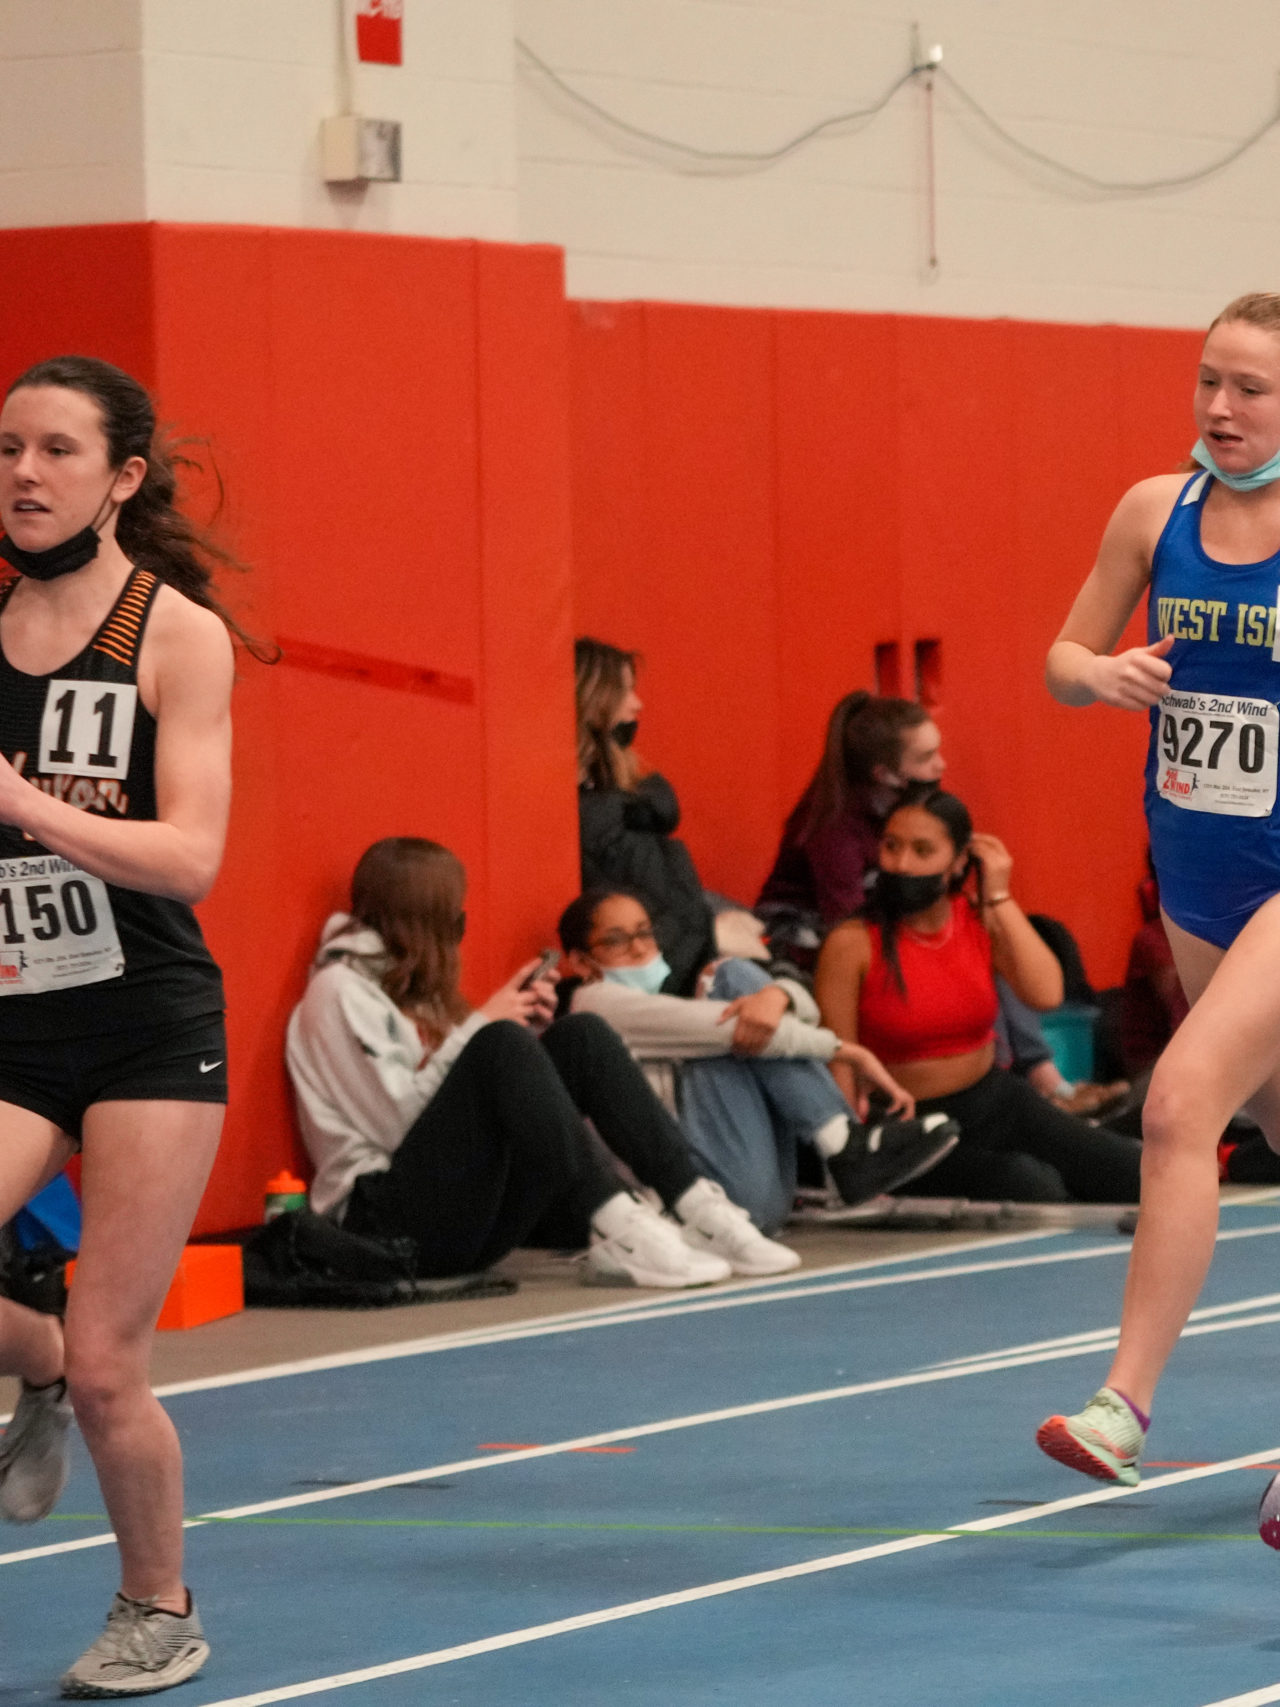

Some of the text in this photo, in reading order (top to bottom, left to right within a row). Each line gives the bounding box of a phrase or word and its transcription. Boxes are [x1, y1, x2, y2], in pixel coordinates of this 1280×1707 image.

[1158, 597, 1228, 642] WEST
[49, 690, 117, 768] 11
[1208, 699, 1234, 713] 2nd
[1237, 701, 1269, 717] Wind
[1163, 714, 1265, 774] 9270
[20, 860, 45, 876] 2nd
[0, 880, 97, 944] 150
